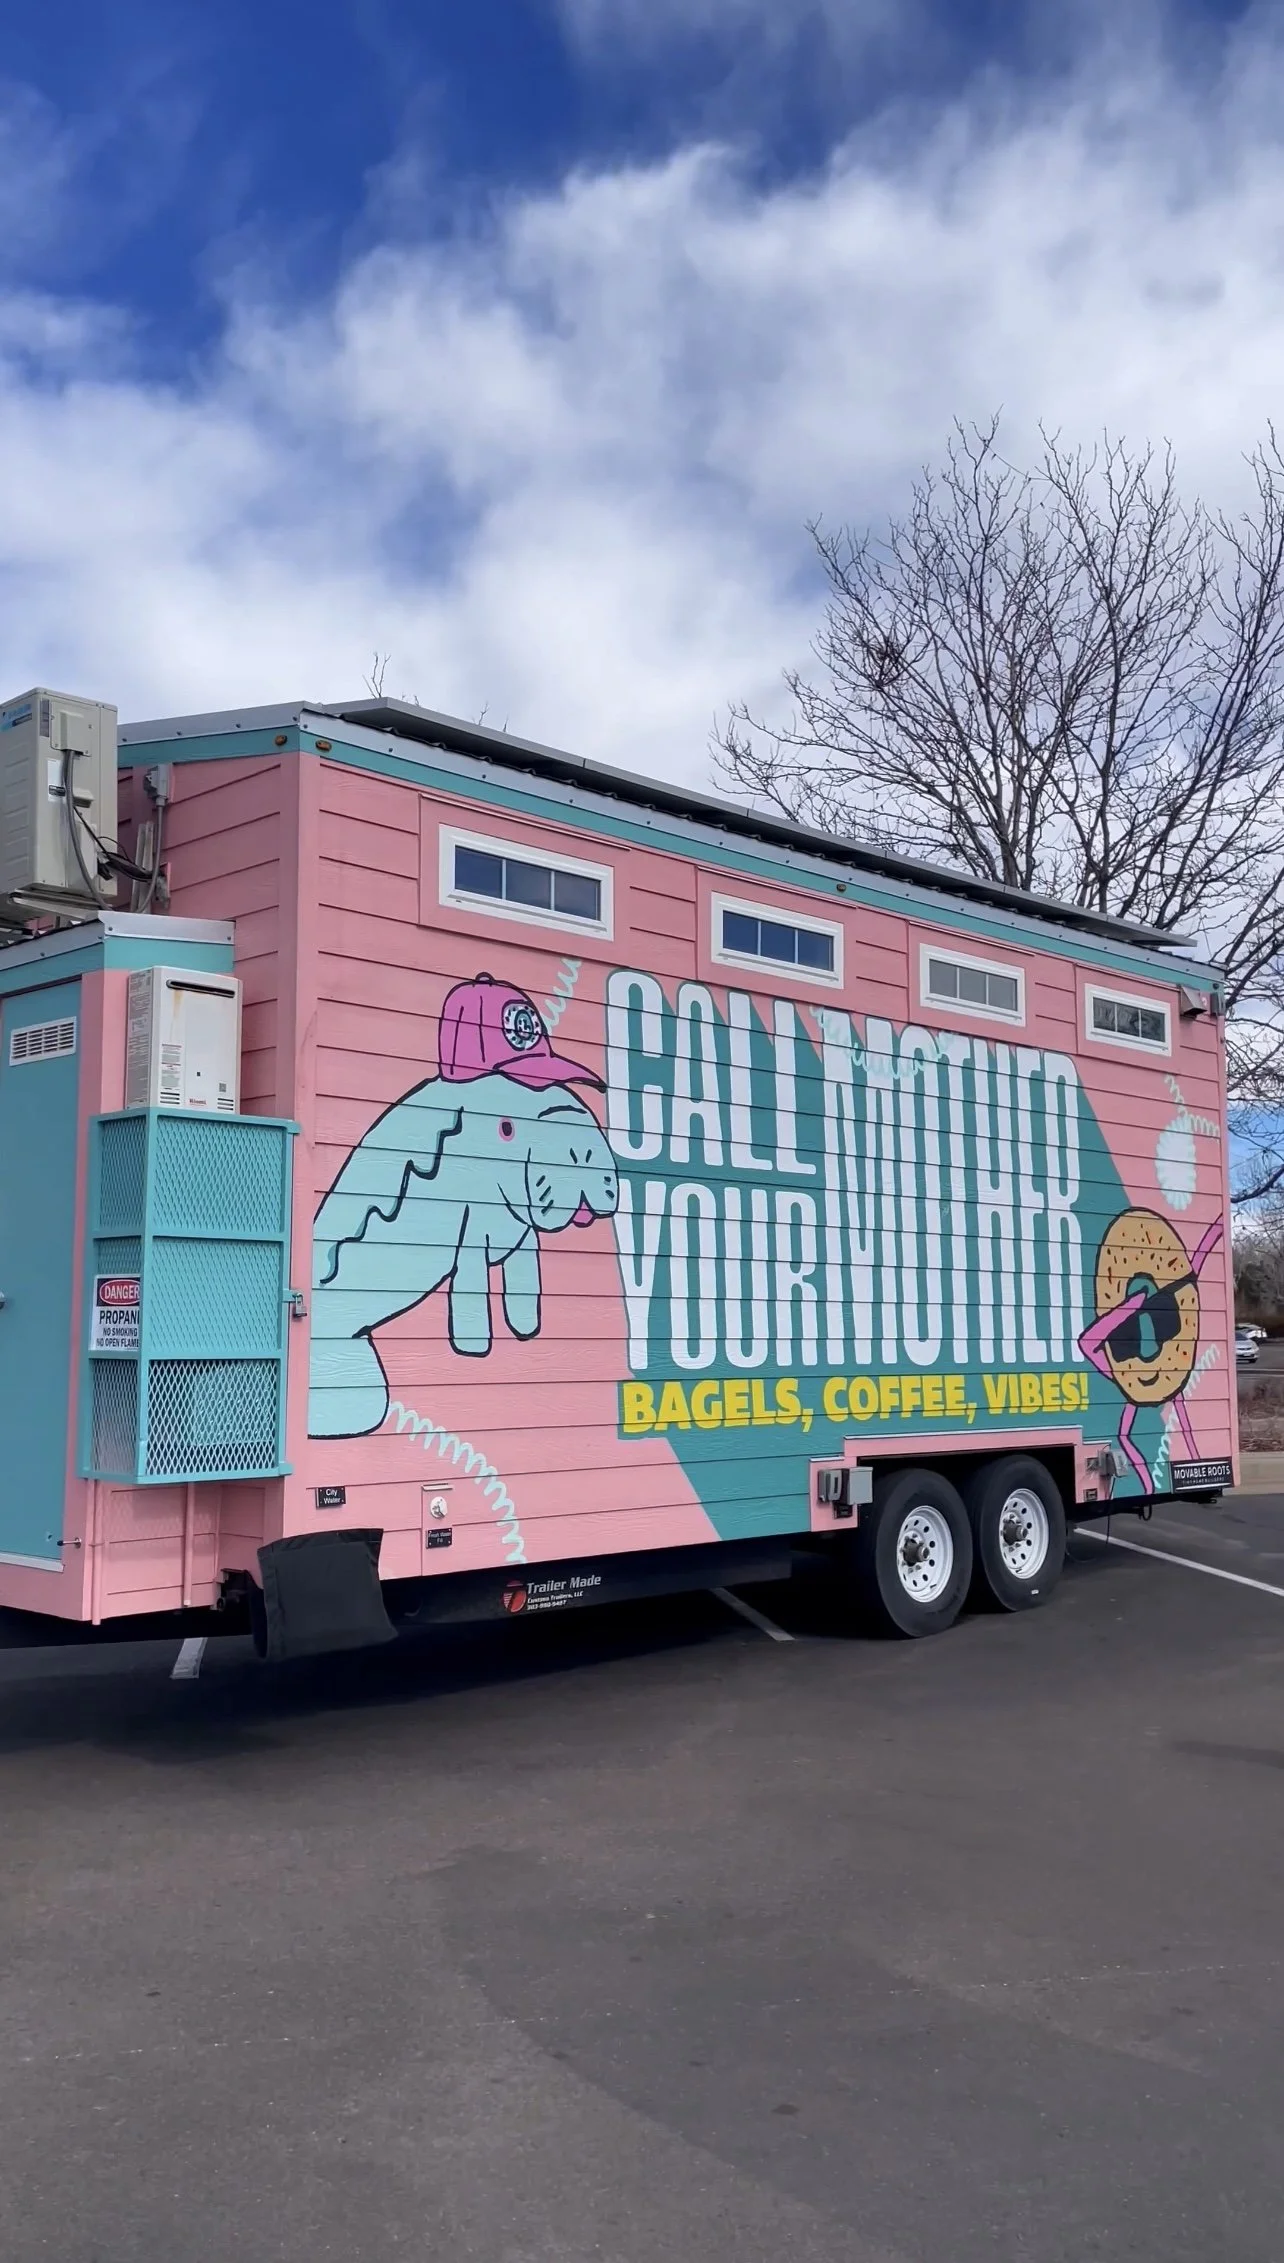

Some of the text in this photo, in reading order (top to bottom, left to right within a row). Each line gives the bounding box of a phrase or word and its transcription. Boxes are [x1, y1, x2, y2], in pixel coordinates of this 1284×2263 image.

[607, 971, 817, 1175] CALL
[823, 1008, 1085, 1365] MOTHER
[616, 1178, 818, 1370] YOUR
[104, 1284, 140, 1300] DANGER
[99, 1310, 140, 1325] PROPAN
[103, 1328, 138, 1337] NO SMOKING
[96, 1338, 104, 1347] NO
[105, 1338, 120, 1347] OPEN
[622, 1372, 1090, 1434] BAGELS, COFFEE, VIBES!
[1174, 1465, 1231, 1480] MOVABLE ROOTS
[325, 1488, 338, 1497] City
[527, 1575, 602, 1594] Trailer Made
